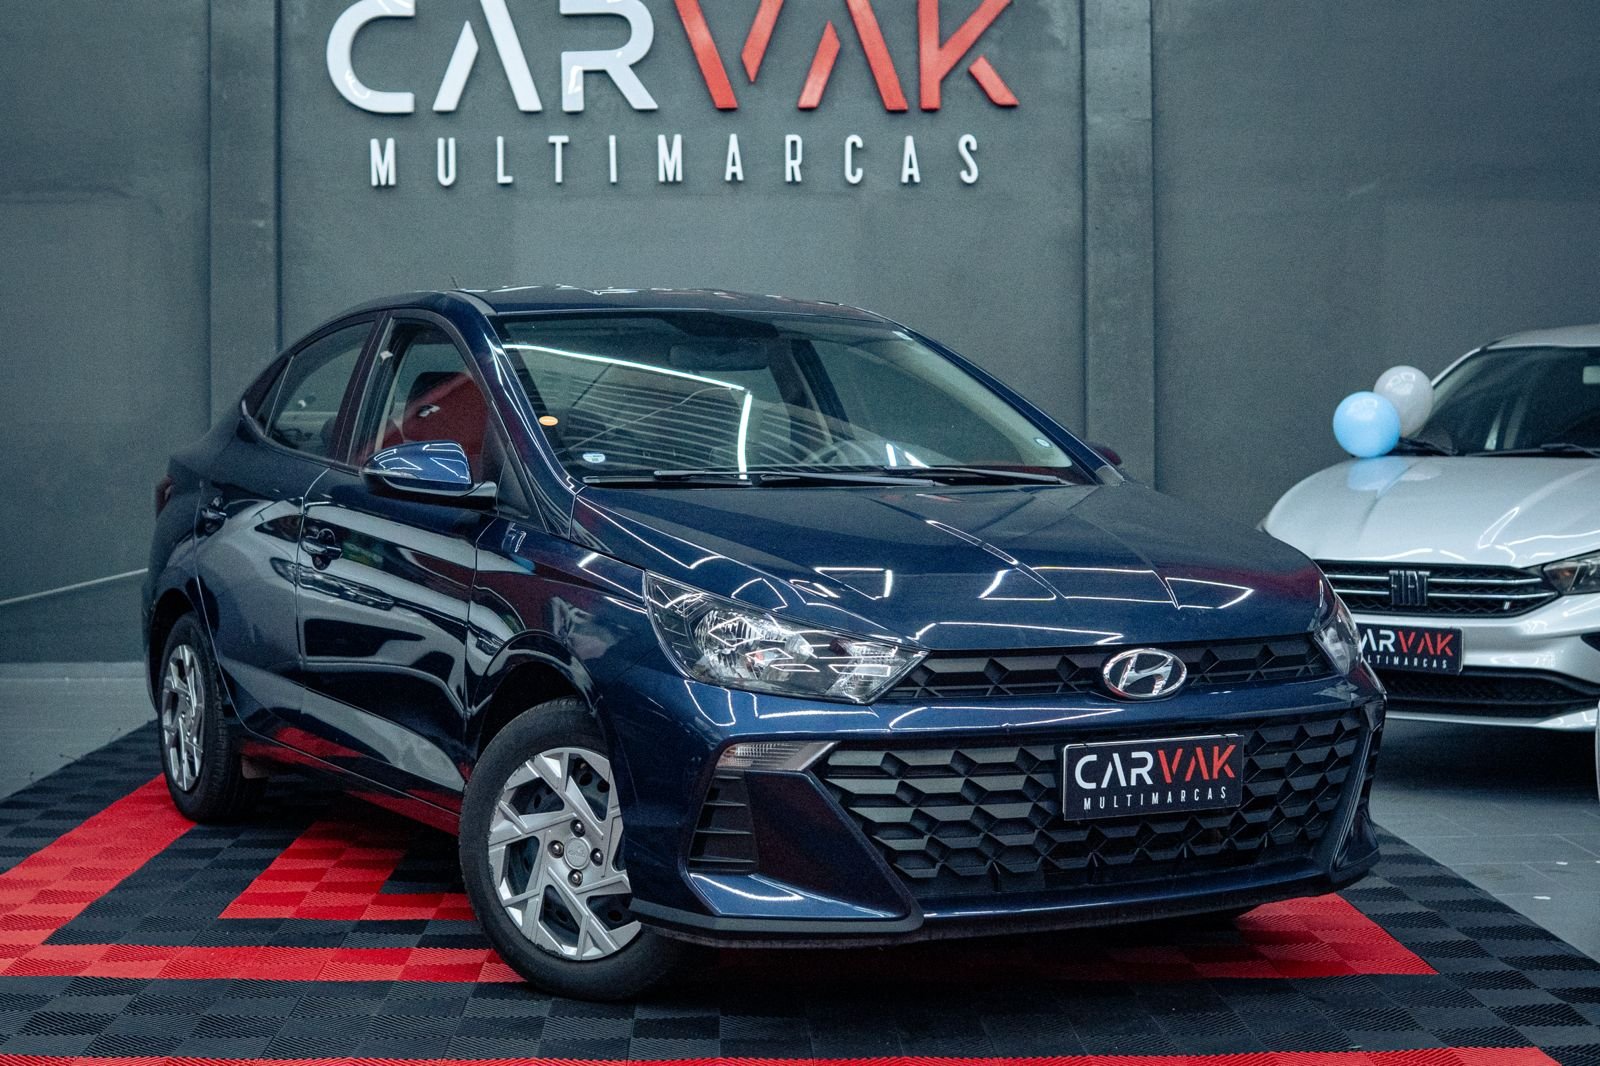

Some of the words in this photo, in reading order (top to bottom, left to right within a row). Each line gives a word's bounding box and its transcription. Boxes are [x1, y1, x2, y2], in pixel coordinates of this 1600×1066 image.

[326, 0, 1019, 114] CARVAK
[370, 133, 981, 188] MULTIMARCAS
[1389, 569, 1430, 606] FIAT
[1357, 628, 1454, 657] ARVAK
[1358, 654, 1447, 669] LTIMARCAS
[1075, 745, 1236, 789] CARVAK
[1083, 787, 1226, 810] MULTIMARCAS
